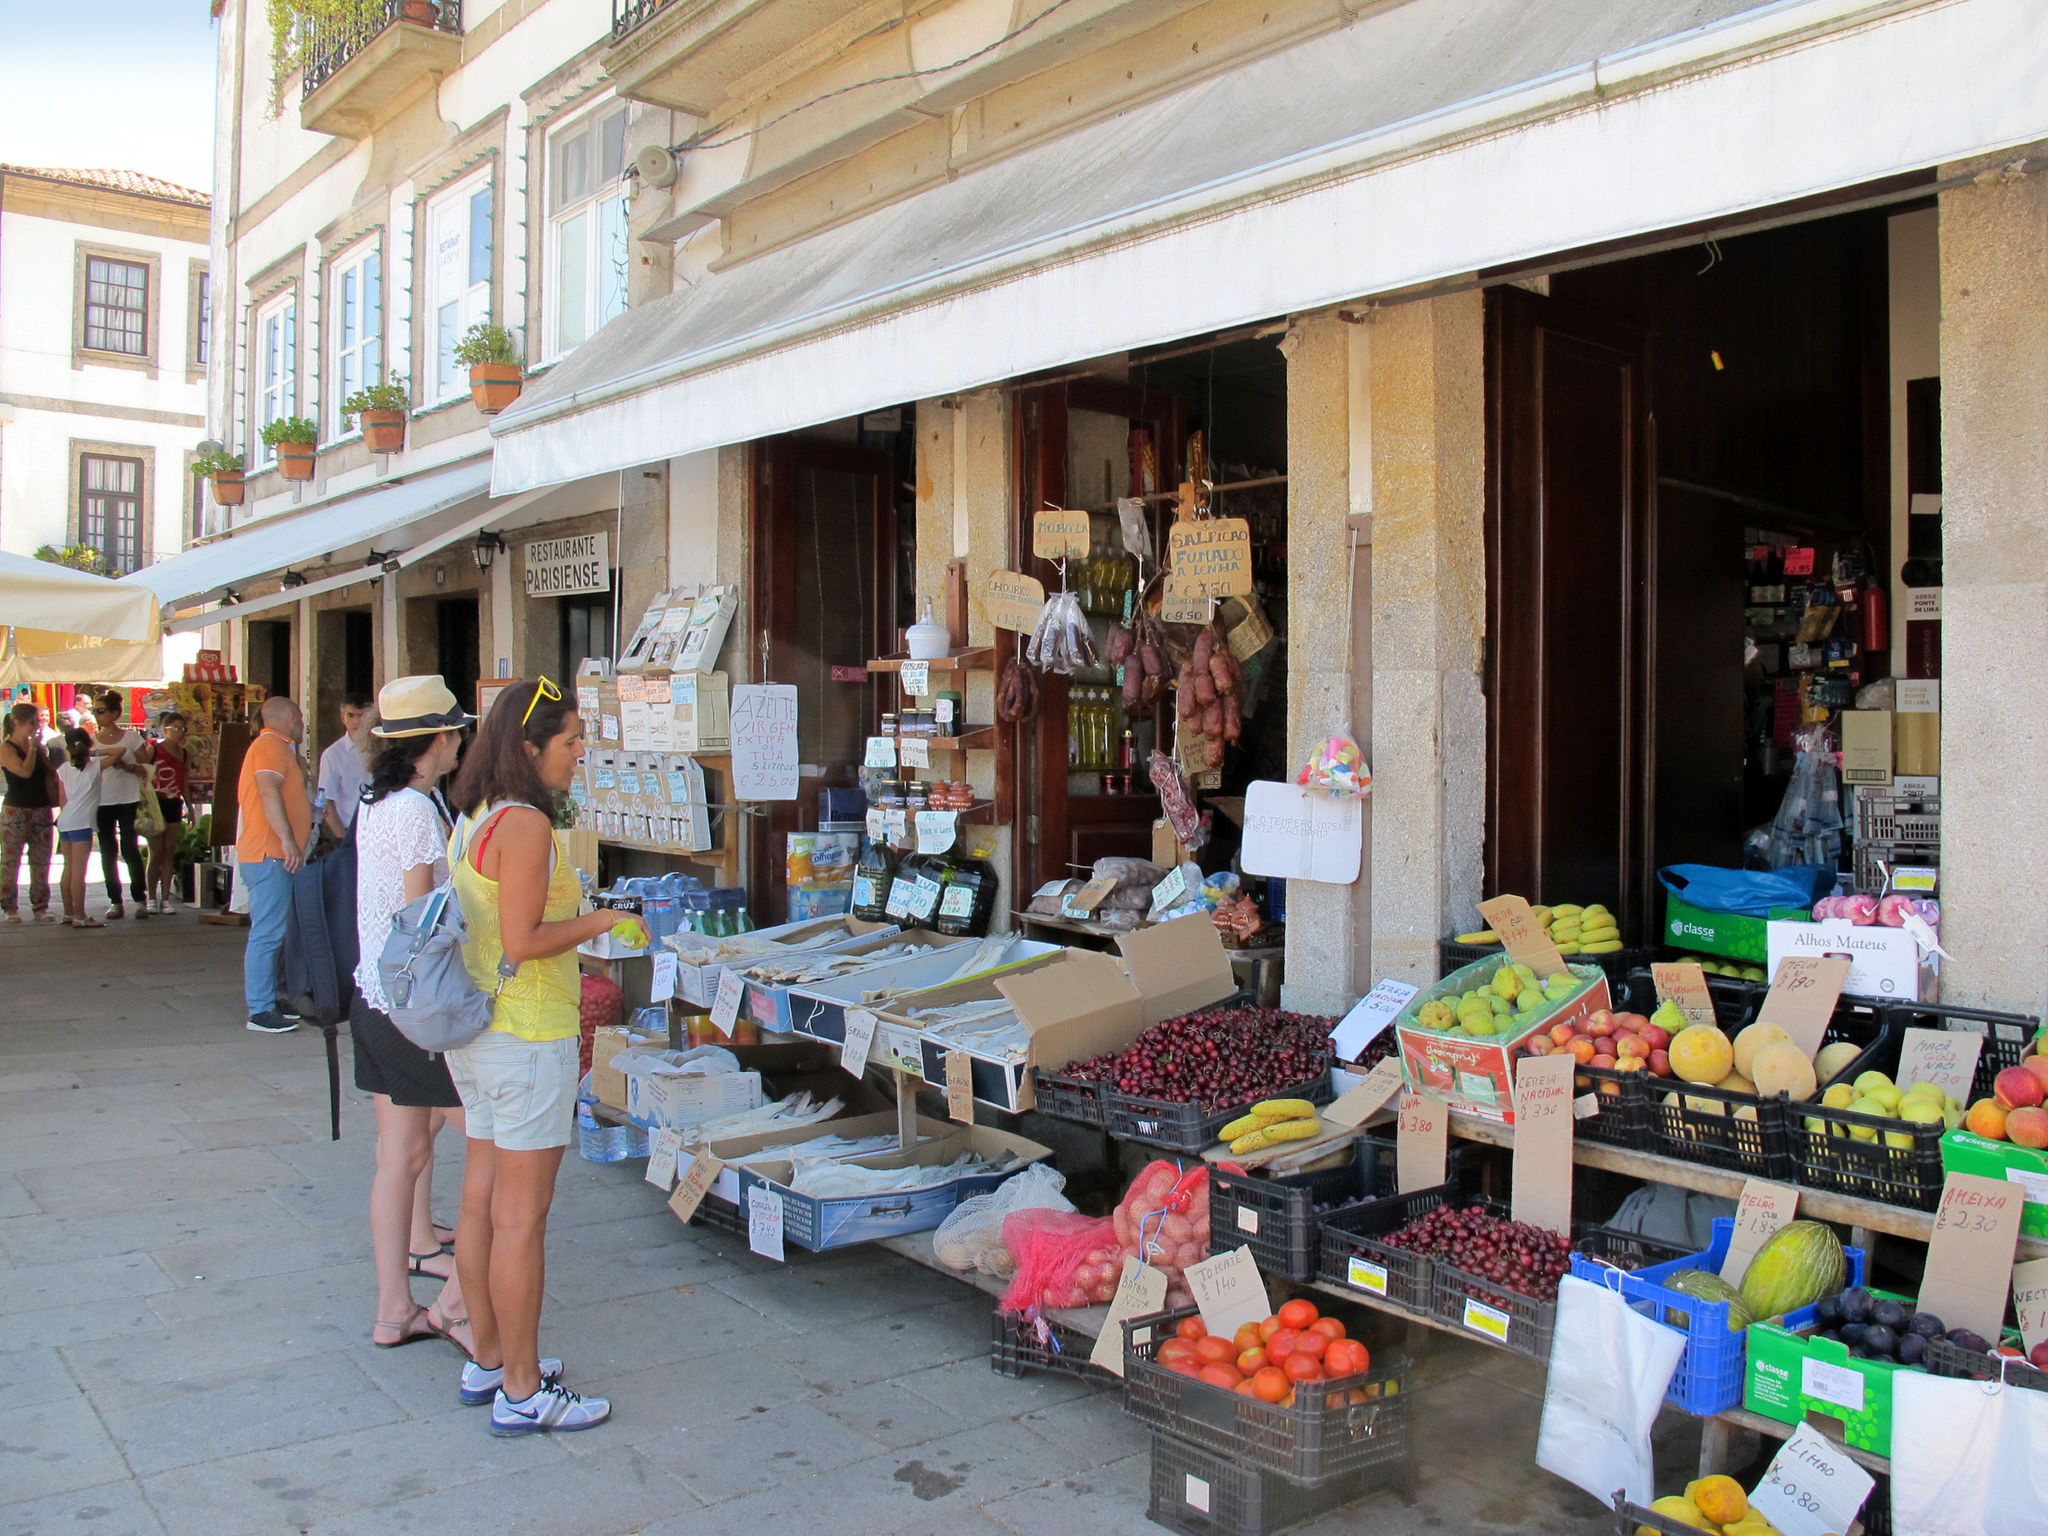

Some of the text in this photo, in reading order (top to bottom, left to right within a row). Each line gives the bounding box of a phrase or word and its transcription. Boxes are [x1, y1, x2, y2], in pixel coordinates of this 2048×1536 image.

[531, 536, 595, 563] RESTAURANTE
[526, 561, 600, 592] PARISIENSE
[1177, 567, 1186, 577] A
[731, 695, 796, 721] AZEITE
[1684, 922, 1714, 937] classe
[1794, 933, 1887, 951] Alhos Mateus
[1400, 1098, 1420, 1110] UVA
[1943, 1187, 2007, 1210] AMEIXA
[1195, 1254, 1241, 1282] TOMATE
[1765, 1363, 1789, 1378] classe
[1783, 1483, 1821, 1512] 0.80
